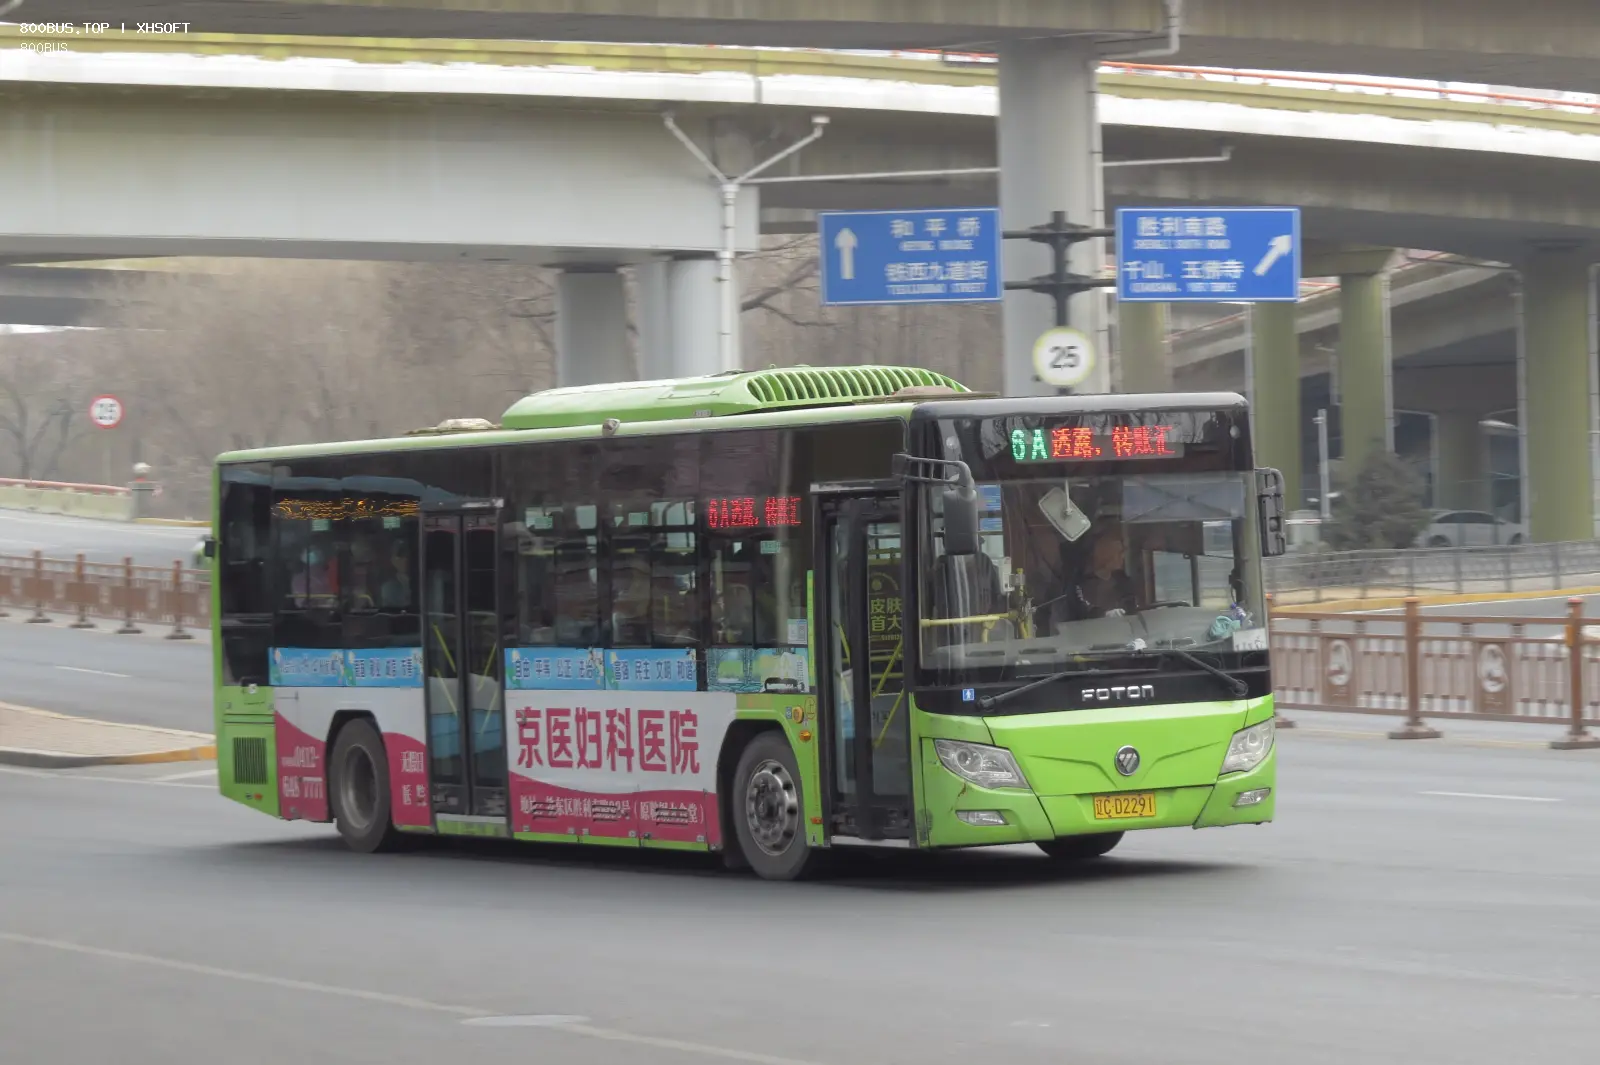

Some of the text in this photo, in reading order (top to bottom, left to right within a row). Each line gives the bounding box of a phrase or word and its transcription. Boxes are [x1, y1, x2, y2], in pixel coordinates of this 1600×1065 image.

[1049, 346, 1080, 368] 25
[1011, 429, 1047, 460] 6A
[557, 658, 572, 677] 公正
[635, 660, 651, 680] 民主
[656, 660, 672, 680] 文明
[1081, 685, 1155, 701] FOTON
[515, 706, 701, 775] 京医妇科医院
